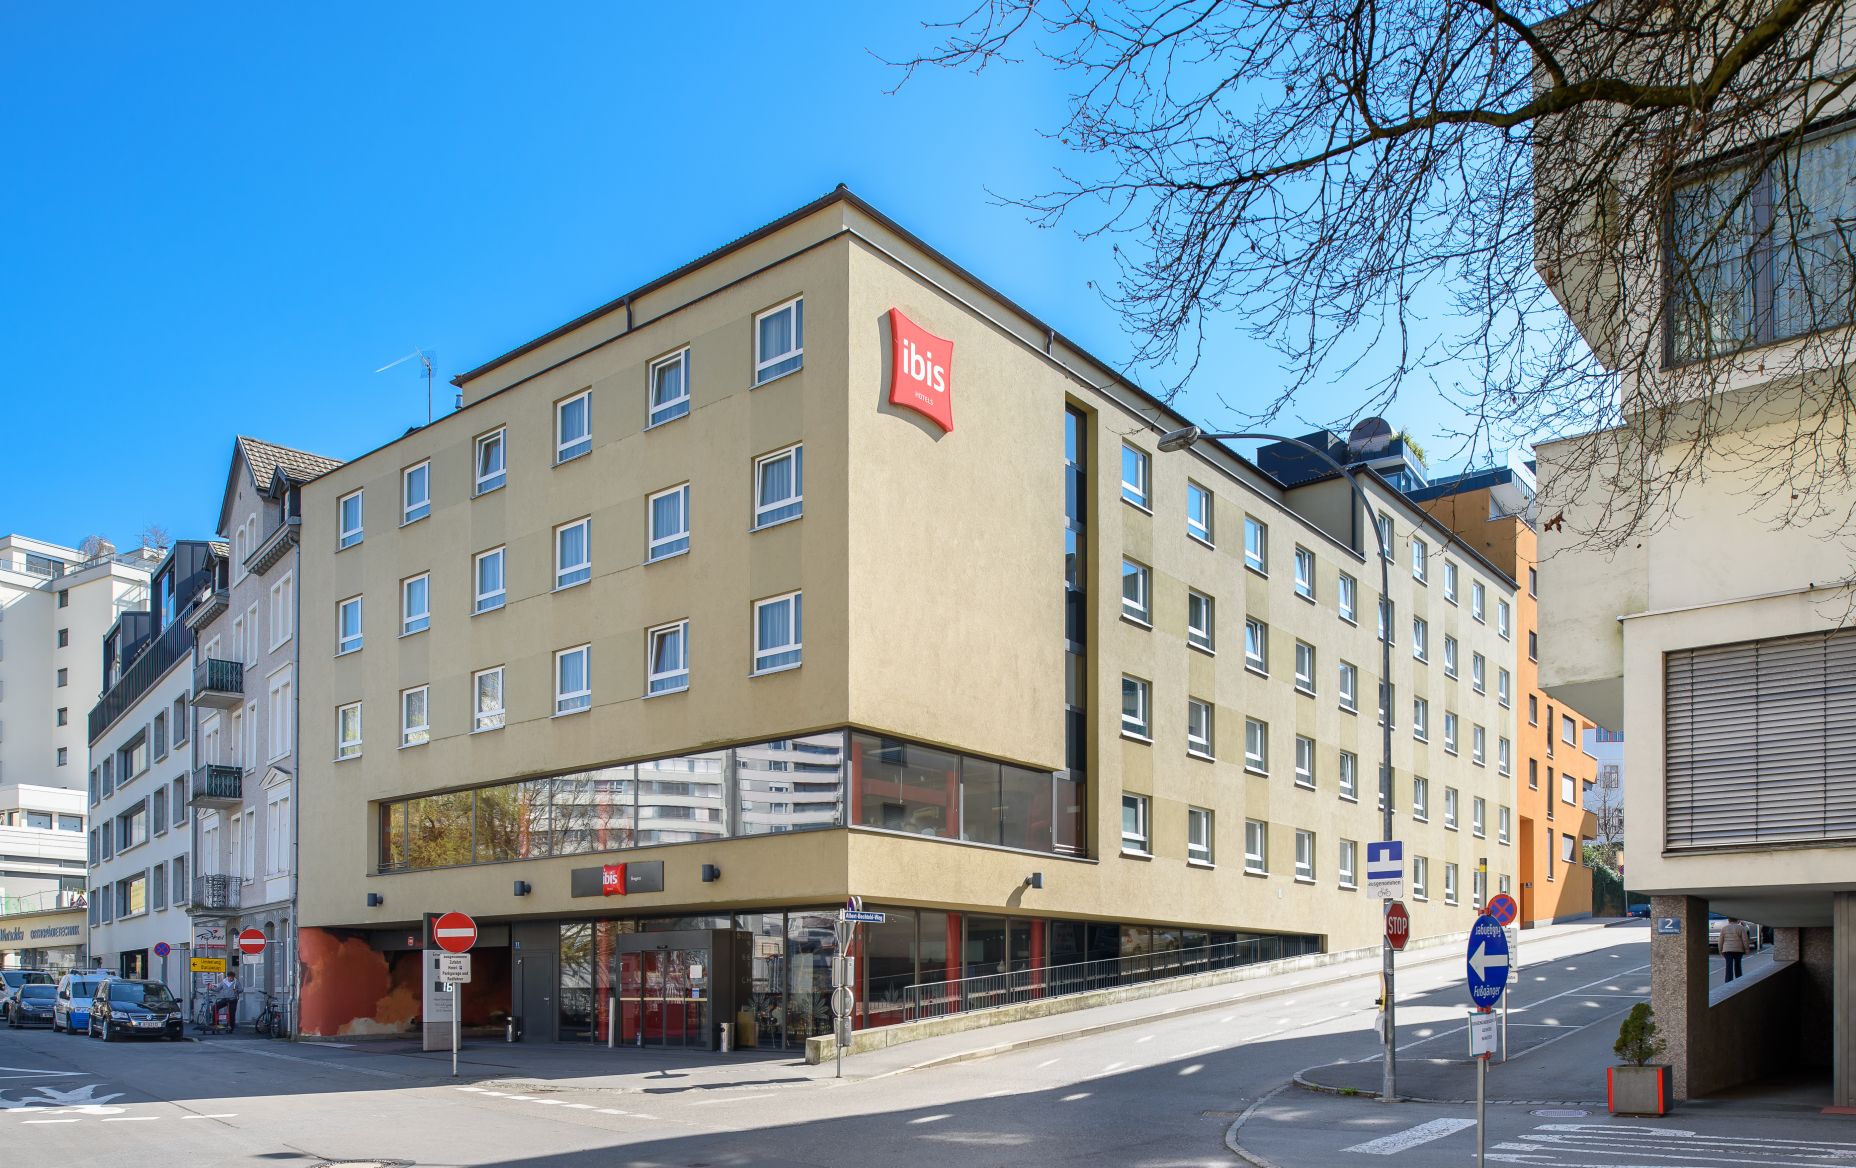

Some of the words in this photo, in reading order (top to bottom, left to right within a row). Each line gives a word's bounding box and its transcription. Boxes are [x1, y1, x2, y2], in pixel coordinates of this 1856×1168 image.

[904, 338, 945, 392] ibis
[915, 392, 934, 405] HOTELS
[603, 868, 618, 884] ibis
[1388, 916, 1408, 935] STOP
[1475, 924, 1501, 937] Fußgänger
[1664, 918, 1673, 929] 2
[1473, 985, 1501, 999] Fußgänger
